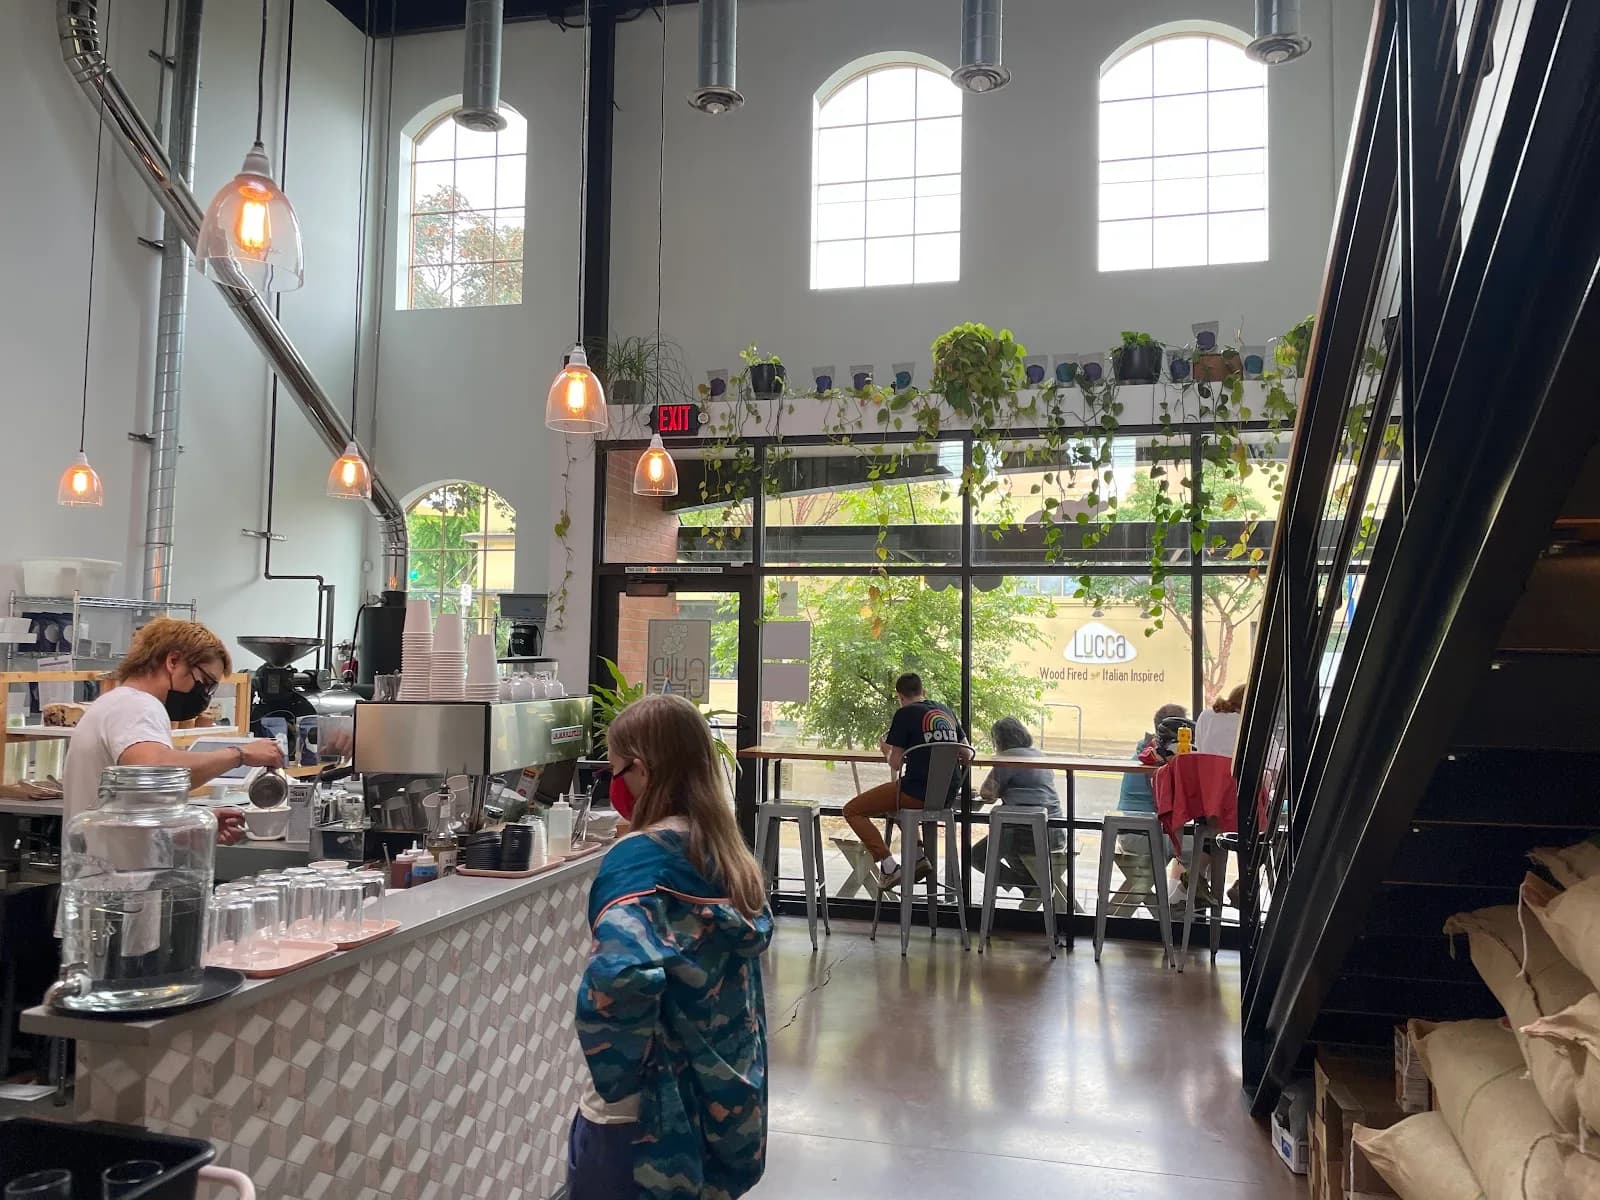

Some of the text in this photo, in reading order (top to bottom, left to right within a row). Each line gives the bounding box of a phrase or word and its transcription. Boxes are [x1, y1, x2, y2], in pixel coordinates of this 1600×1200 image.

[658, 405, 690, 431] EXIT
[1074, 630, 1126, 658] Lucca
[1039, 667, 1065, 680] Wood
[1067, 667, 1088, 680] Fired
[1102, 668, 1128, 681] Italian
[1131, 669, 1165, 683] Inspired
